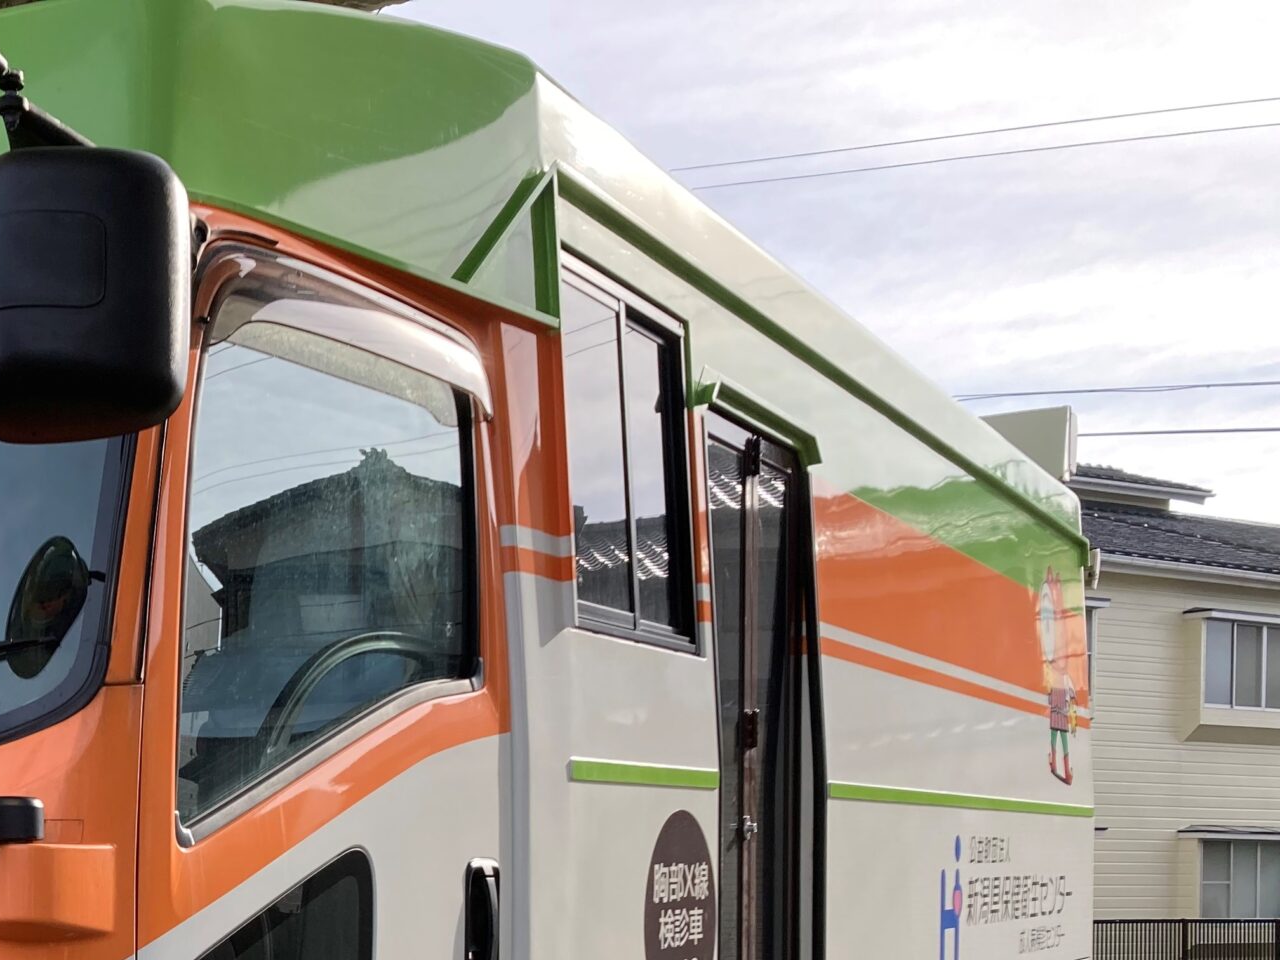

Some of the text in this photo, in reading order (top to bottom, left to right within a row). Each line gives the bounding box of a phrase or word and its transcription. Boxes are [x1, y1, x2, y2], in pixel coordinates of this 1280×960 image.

[653, 862, 709, 904] 胸部X線
[659, 907, 704, 950] 検診車
